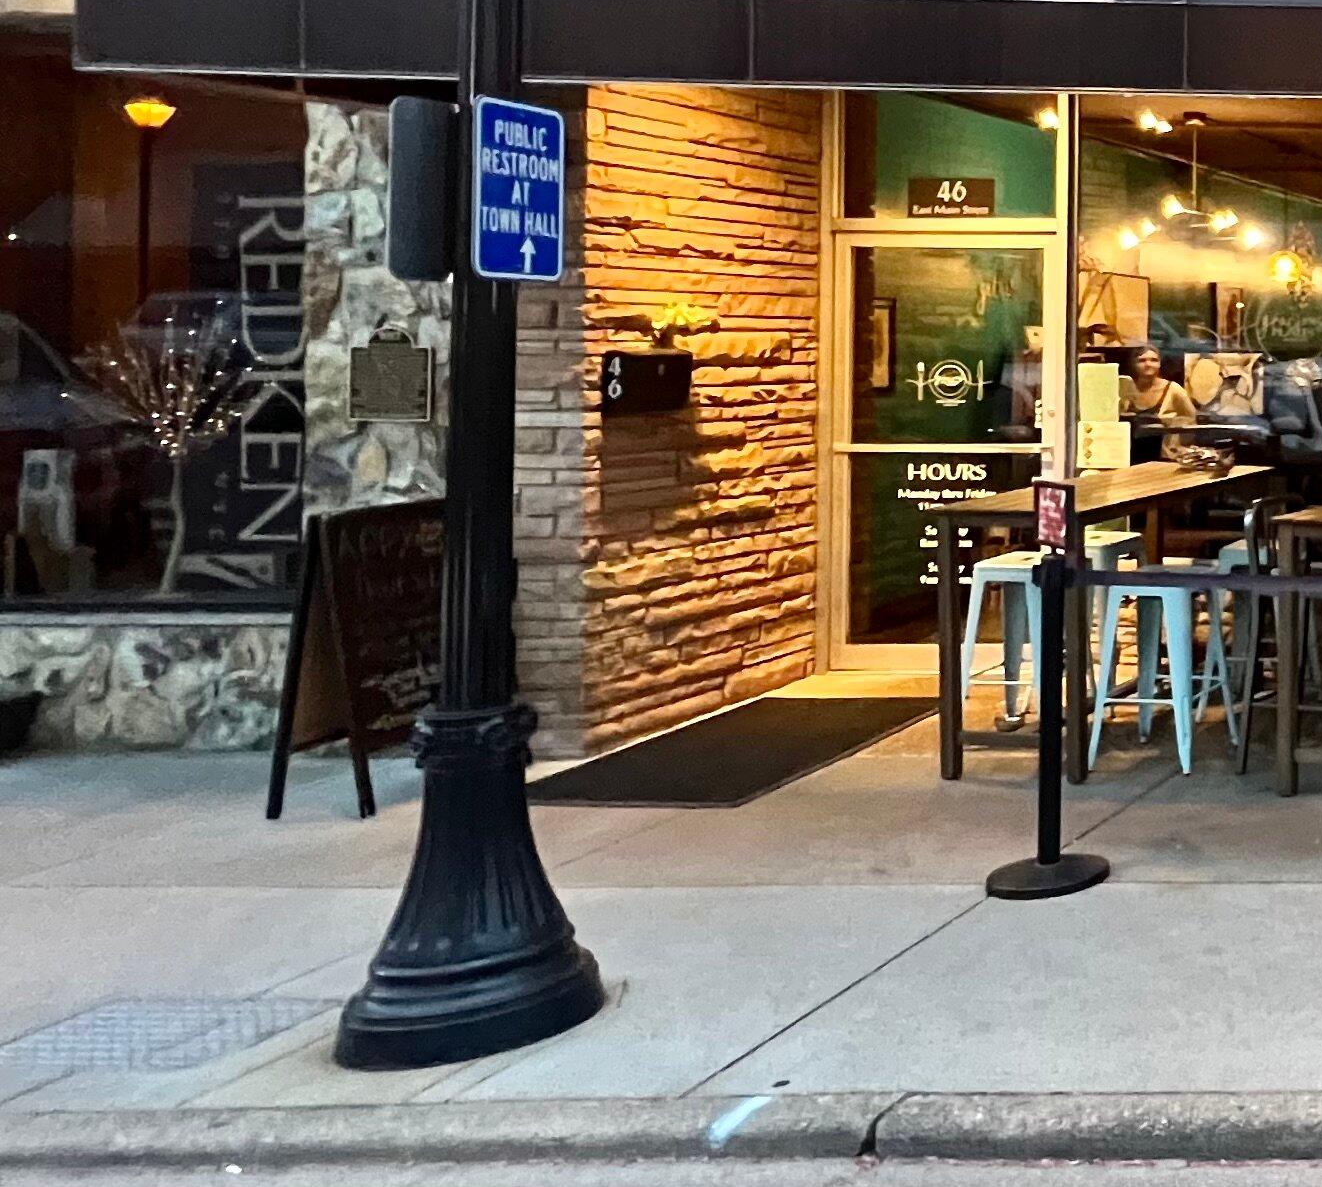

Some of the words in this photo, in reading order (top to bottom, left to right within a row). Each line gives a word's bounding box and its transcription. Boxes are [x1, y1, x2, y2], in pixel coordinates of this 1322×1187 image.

[494, 119, 547, 153] PUBLIC
[481, 146, 560, 183] RESTROOM
[511, 179, 531, 207] AT
[936, 180, 967, 203] 46
[482, 205, 521, 234] TOWN
[524, 211, 559, 239] HALL
[238, 195, 306, 542] REDKEN
[907, 463, 987, 481] HOURS
